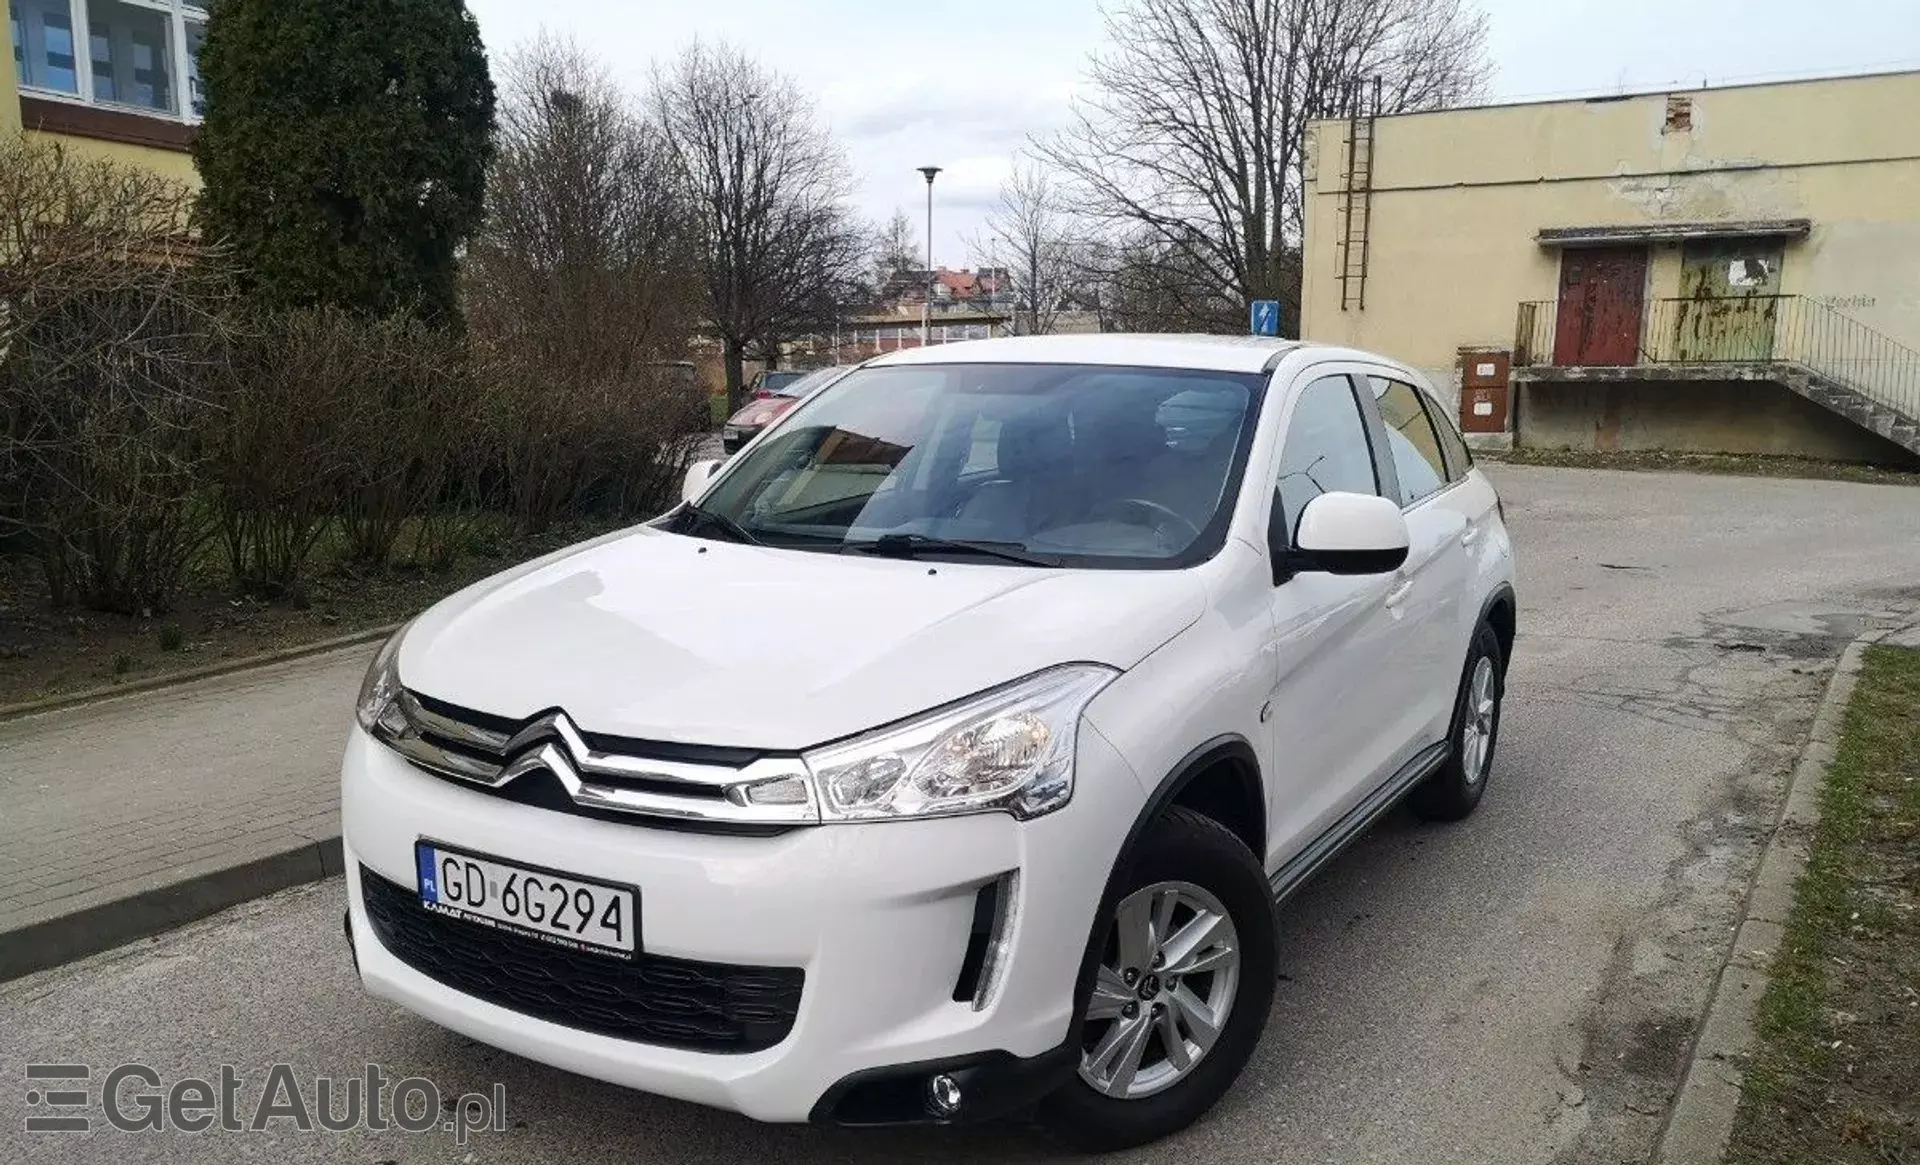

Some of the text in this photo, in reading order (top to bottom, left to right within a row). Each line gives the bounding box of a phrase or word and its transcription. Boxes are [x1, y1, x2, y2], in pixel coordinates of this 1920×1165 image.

[423, 878, 436, 893] PL
[442, 857, 622, 942] GD 6G294
